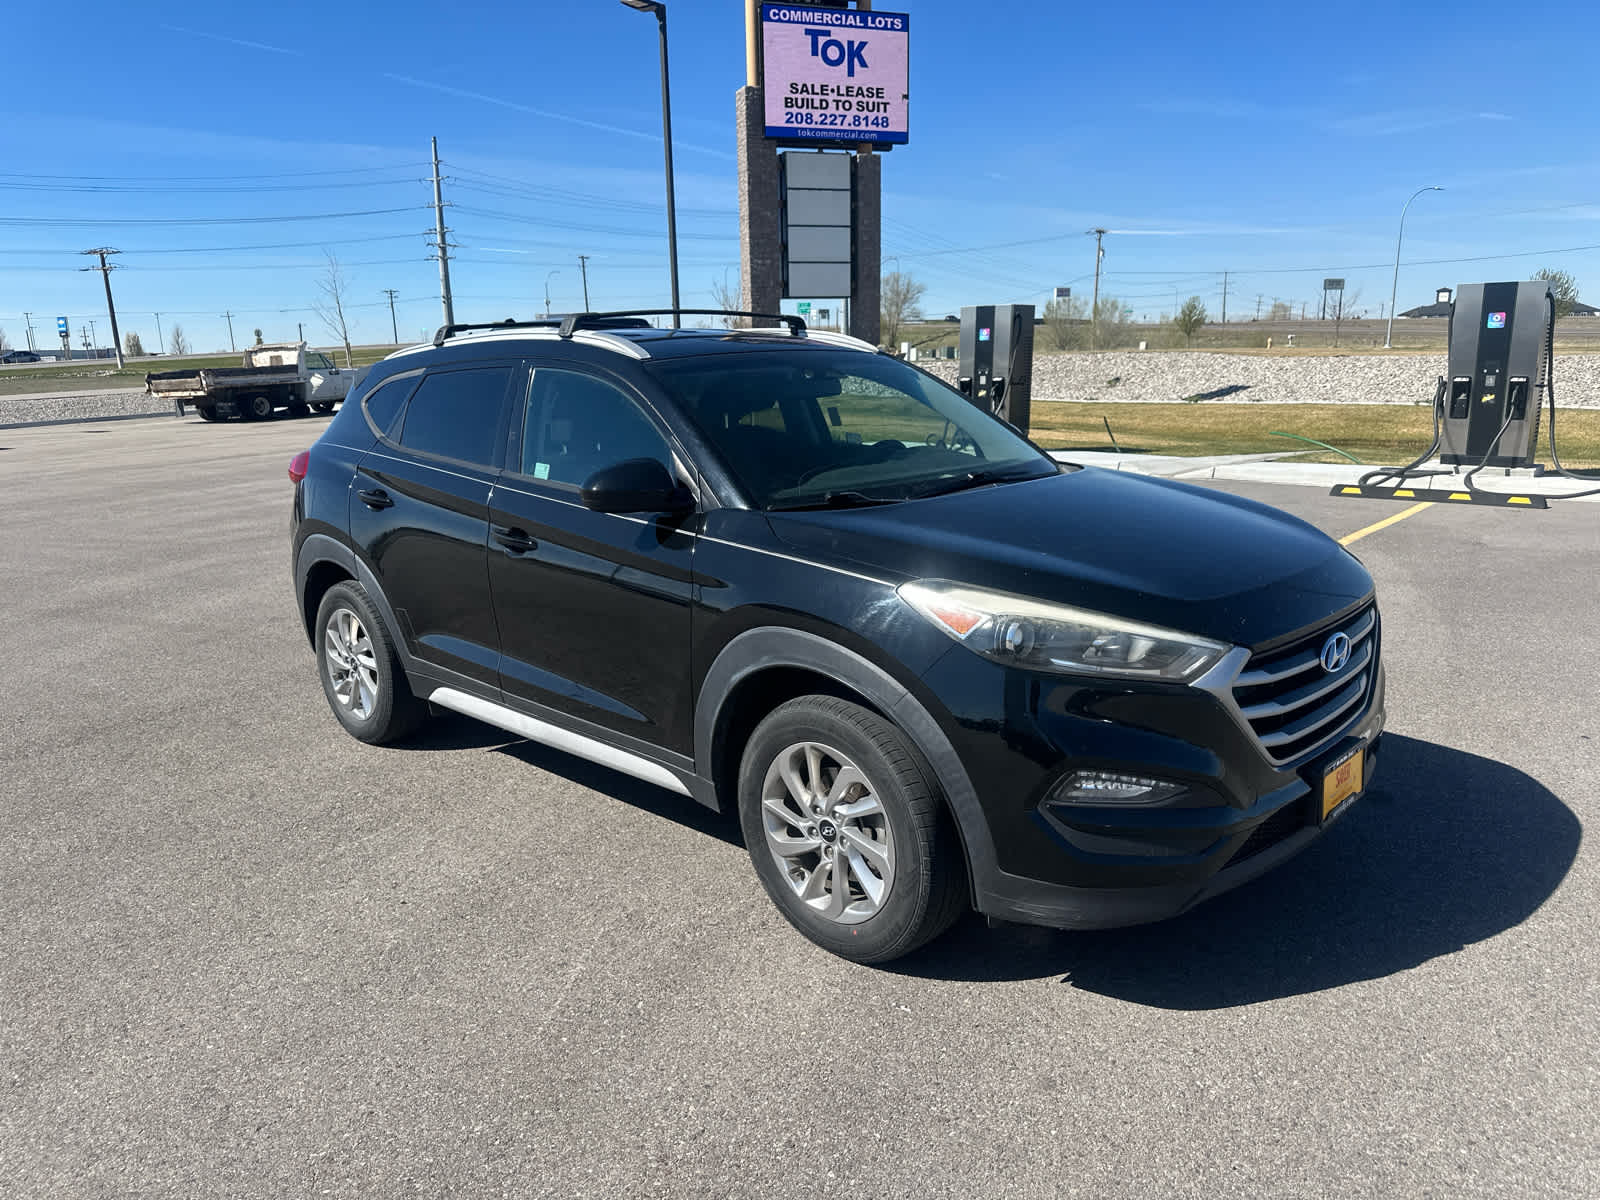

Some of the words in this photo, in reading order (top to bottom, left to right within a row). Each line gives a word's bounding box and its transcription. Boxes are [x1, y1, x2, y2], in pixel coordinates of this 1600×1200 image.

[769, 9, 864, 26] COMMERCIAL
[867, 16, 902, 29] LOTS
[804, 28, 869, 77] TOK
[784, 97, 829, 111] BUILD
[832, 99, 852, 112] TO
[855, 101, 890, 113] SUIT
[784, 112, 890, 128] 208.227.8148
[797, 129, 878, 140] tokcommercial.com
